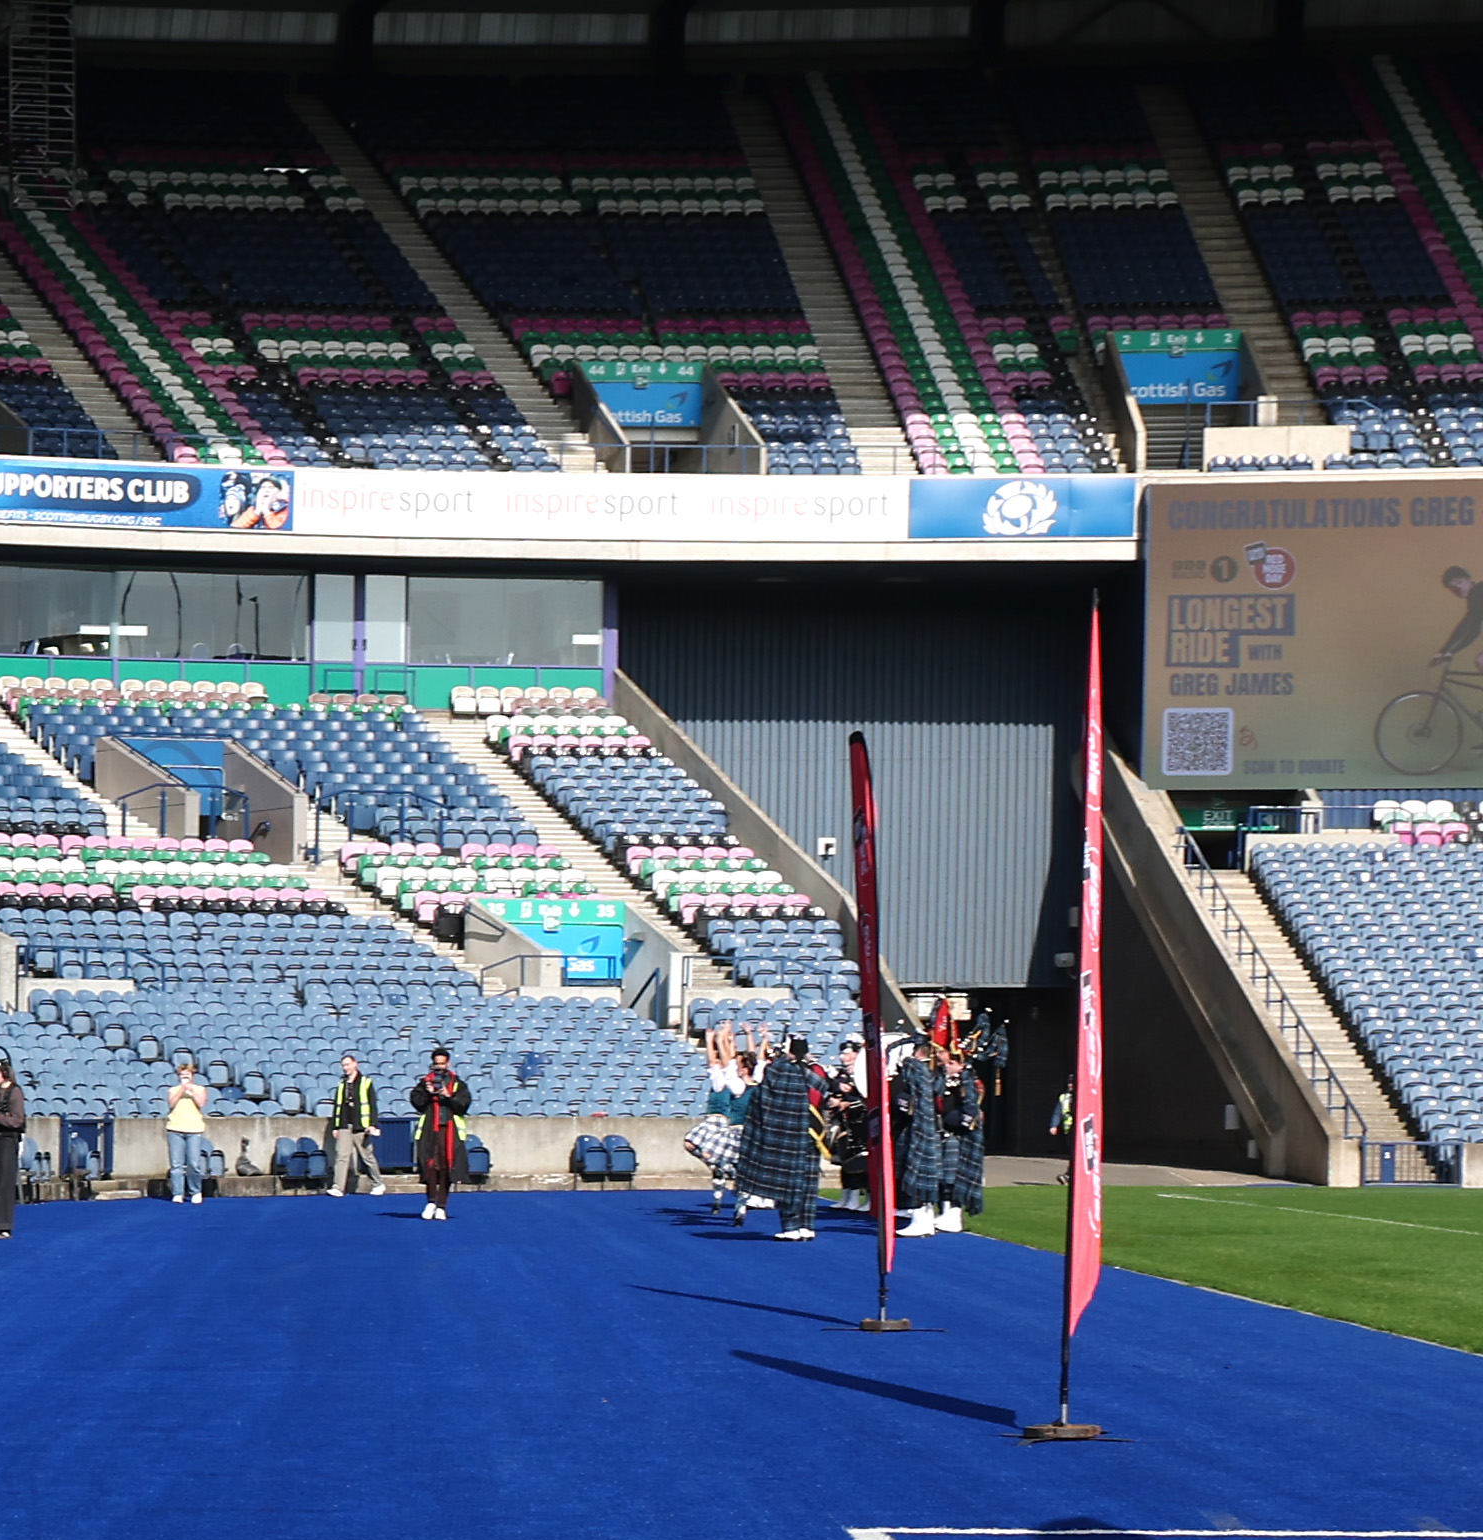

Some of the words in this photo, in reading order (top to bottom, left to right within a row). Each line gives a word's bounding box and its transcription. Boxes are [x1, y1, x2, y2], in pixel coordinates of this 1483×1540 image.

[1122, 334, 1132, 345] 2
[1167, 334, 1188, 345] Exit
[1223, 332, 1233, 343] 2
[588, 365, 606, 376] 44
[631, 364, 652, 374] Exit
[677, 366, 695, 376] 44
[1130, 382, 1189, 398] cottish
[1194, 382, 1227, 397] Gas
[655, 410, 683, 424] Gas
[127, 477, 190, 504] CLUB
[302, 484, 473, 518] inspiresport
[506, 488, 677, 521] inspiresport
[711, 491, 888, 522] inspiresport
[1168, 497, 1403, 530] CONGRATULATIONS
[1410, 495, 1476, 527] GREG
[141, 515, 162, 526] SSC
[1172, 597, 1287, 632] LONGEST
[1171, 631, 1230, 664] RIDE
[1248, 644, 1282, 661] WITH
[1169, 673, 1219, 696] GREG
[1225, 672, 1295, 696] JAMES
[1243, 759, 1277, 775] SCAN
[1280, 759, 1295, 775] TO
[1298, 759, 1346, 775] DONATE
[538, 904, 563, 917] Exit
[596, 904, 617, 918] 35
